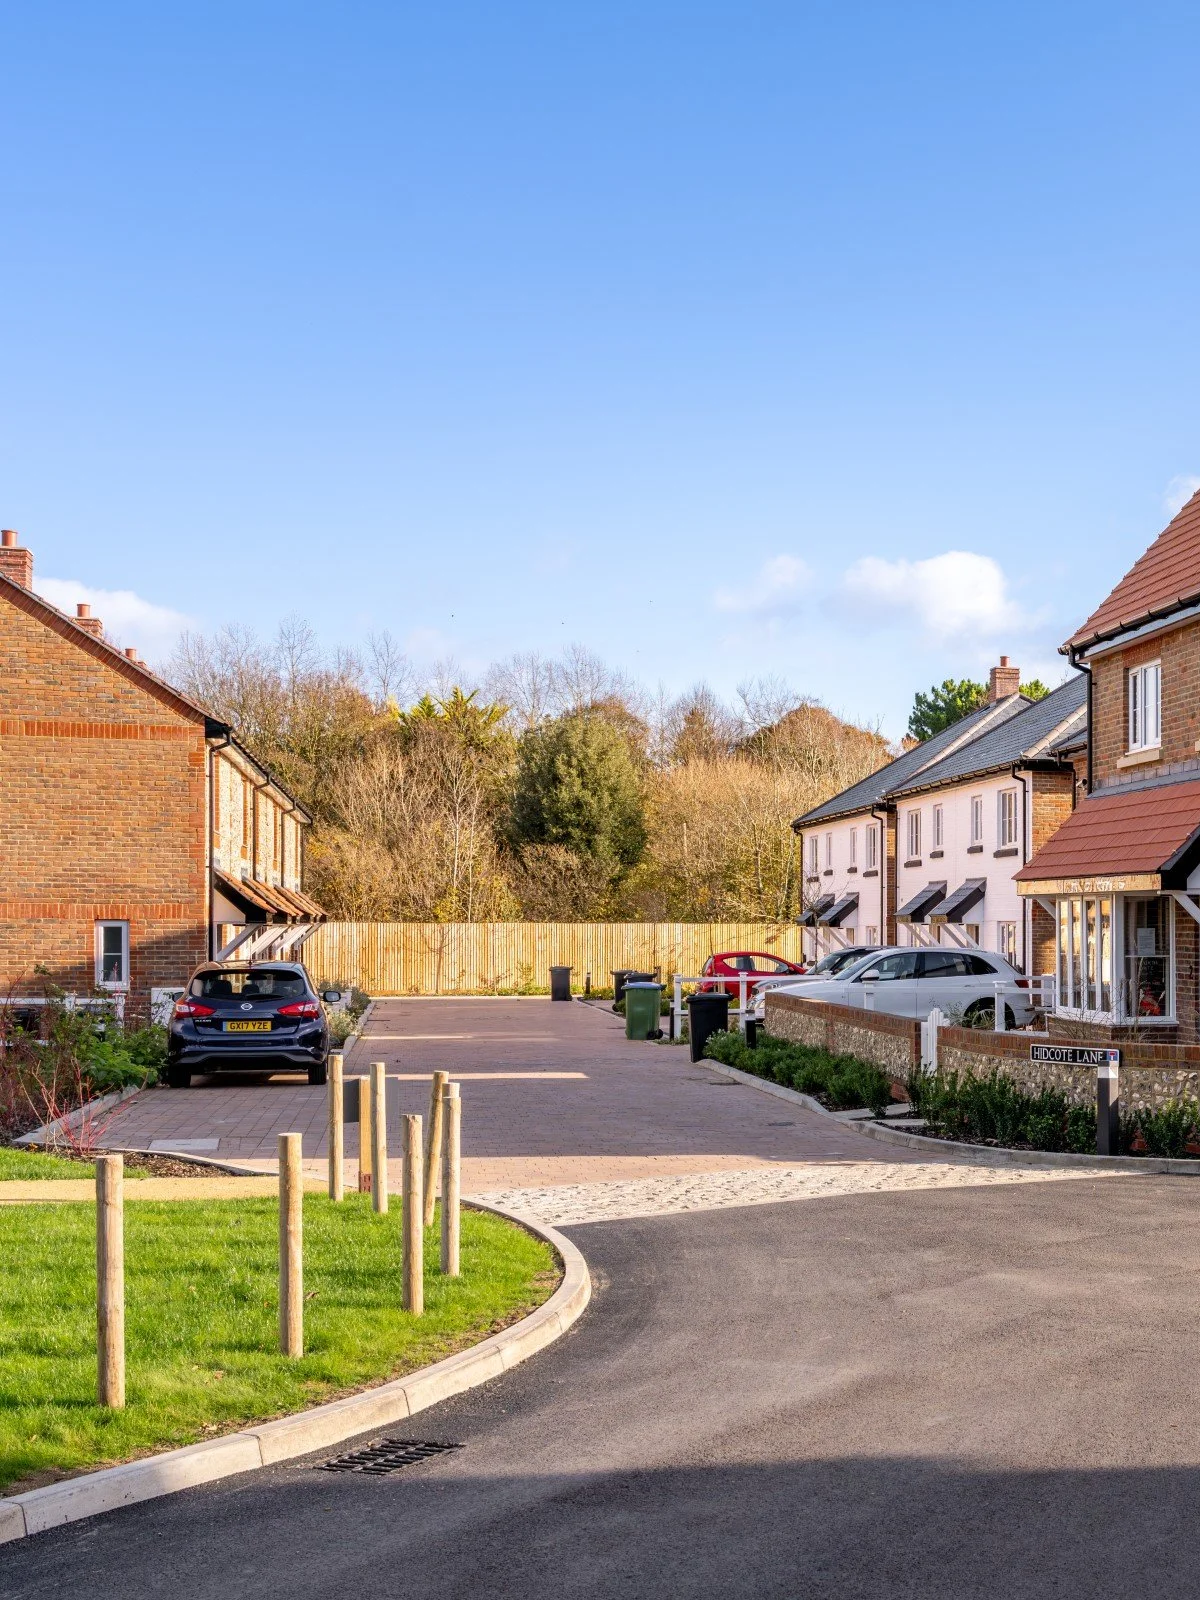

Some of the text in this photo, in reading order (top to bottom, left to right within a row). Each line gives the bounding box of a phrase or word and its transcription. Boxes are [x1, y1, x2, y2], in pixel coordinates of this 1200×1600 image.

[229, 1022, 251, 1030] GX17
[1033, 1046, 1103, 1063] HIDCOTE LANE
